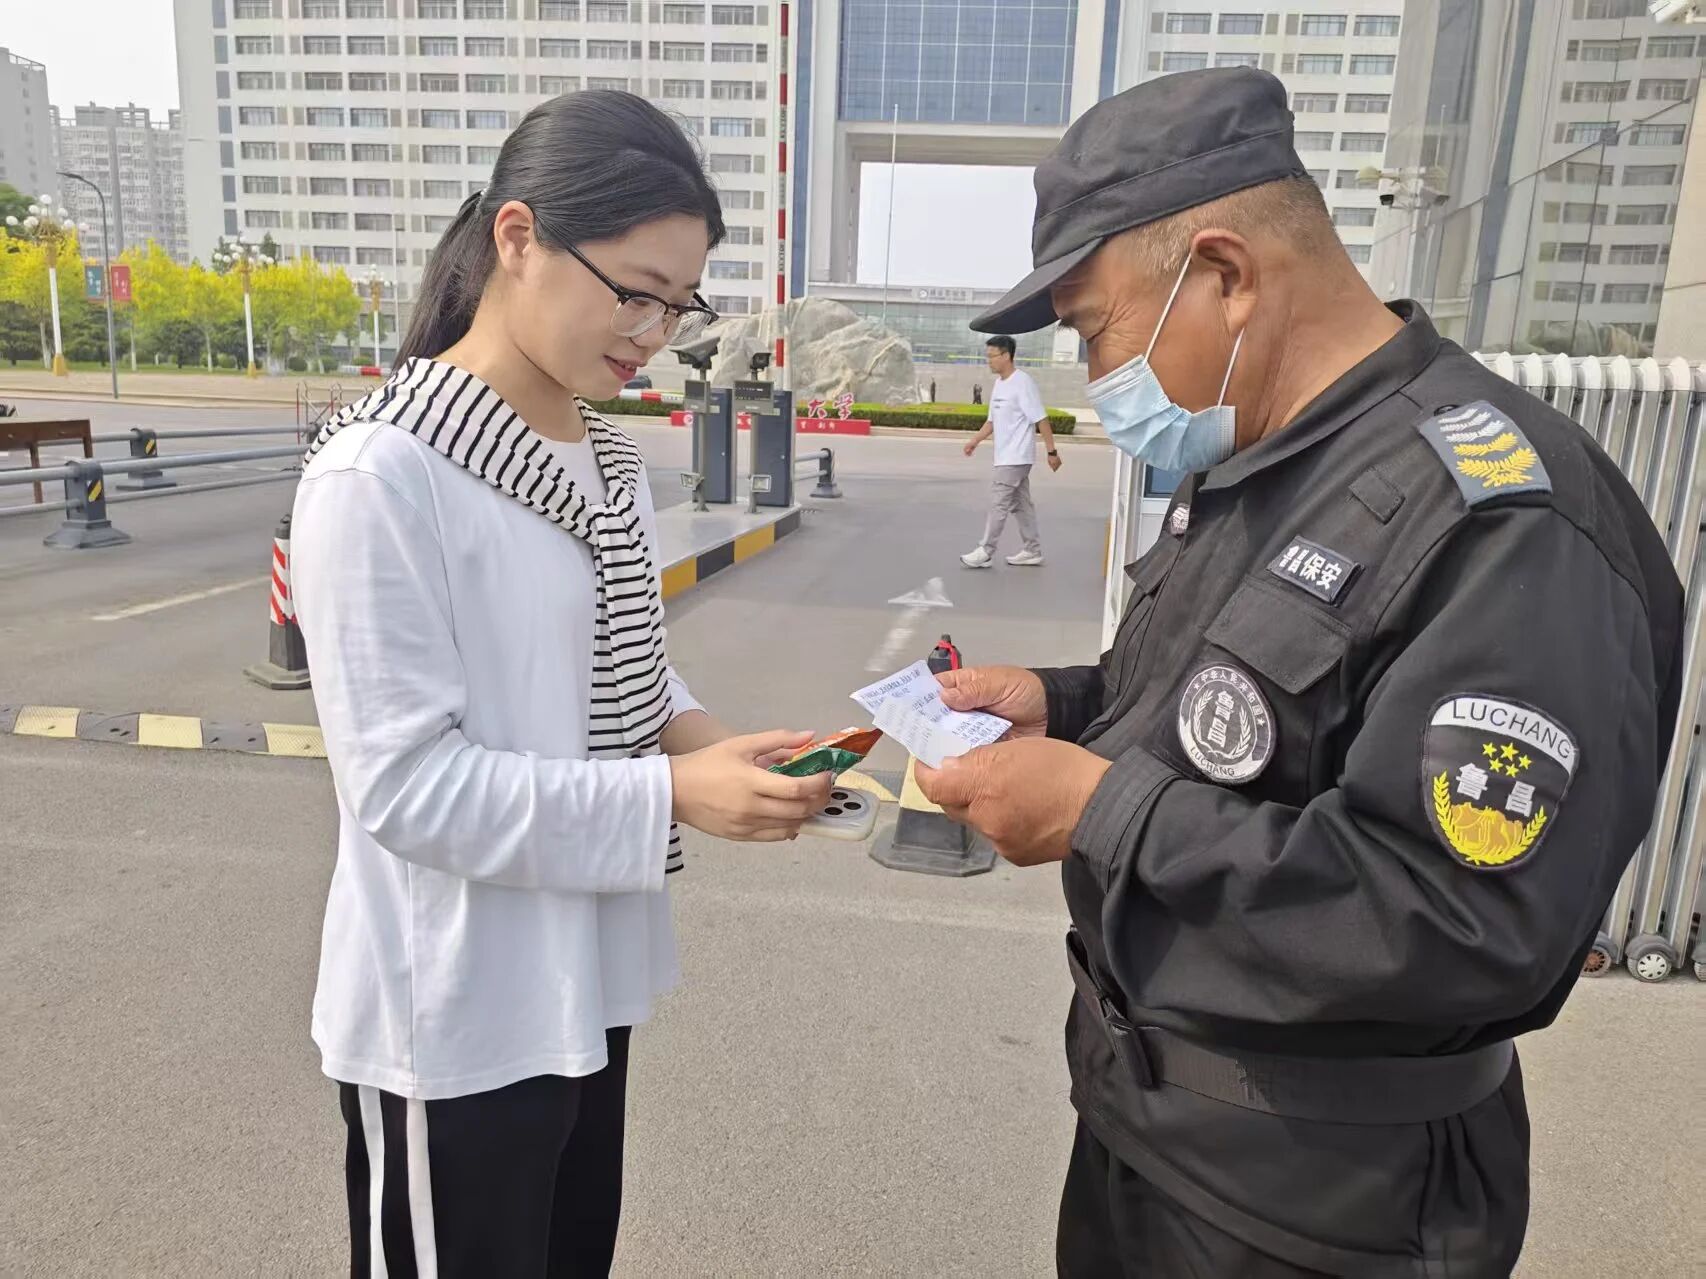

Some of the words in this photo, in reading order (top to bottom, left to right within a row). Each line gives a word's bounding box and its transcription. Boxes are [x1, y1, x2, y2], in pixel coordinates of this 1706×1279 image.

[807, 392, 854, 420] 大学
[1200, 669, 1264, 716] 中华人民共和国
[1453, 700, 1573, 759] LUCHANG
[1190, 746, 1235, 776] LUCHANG
